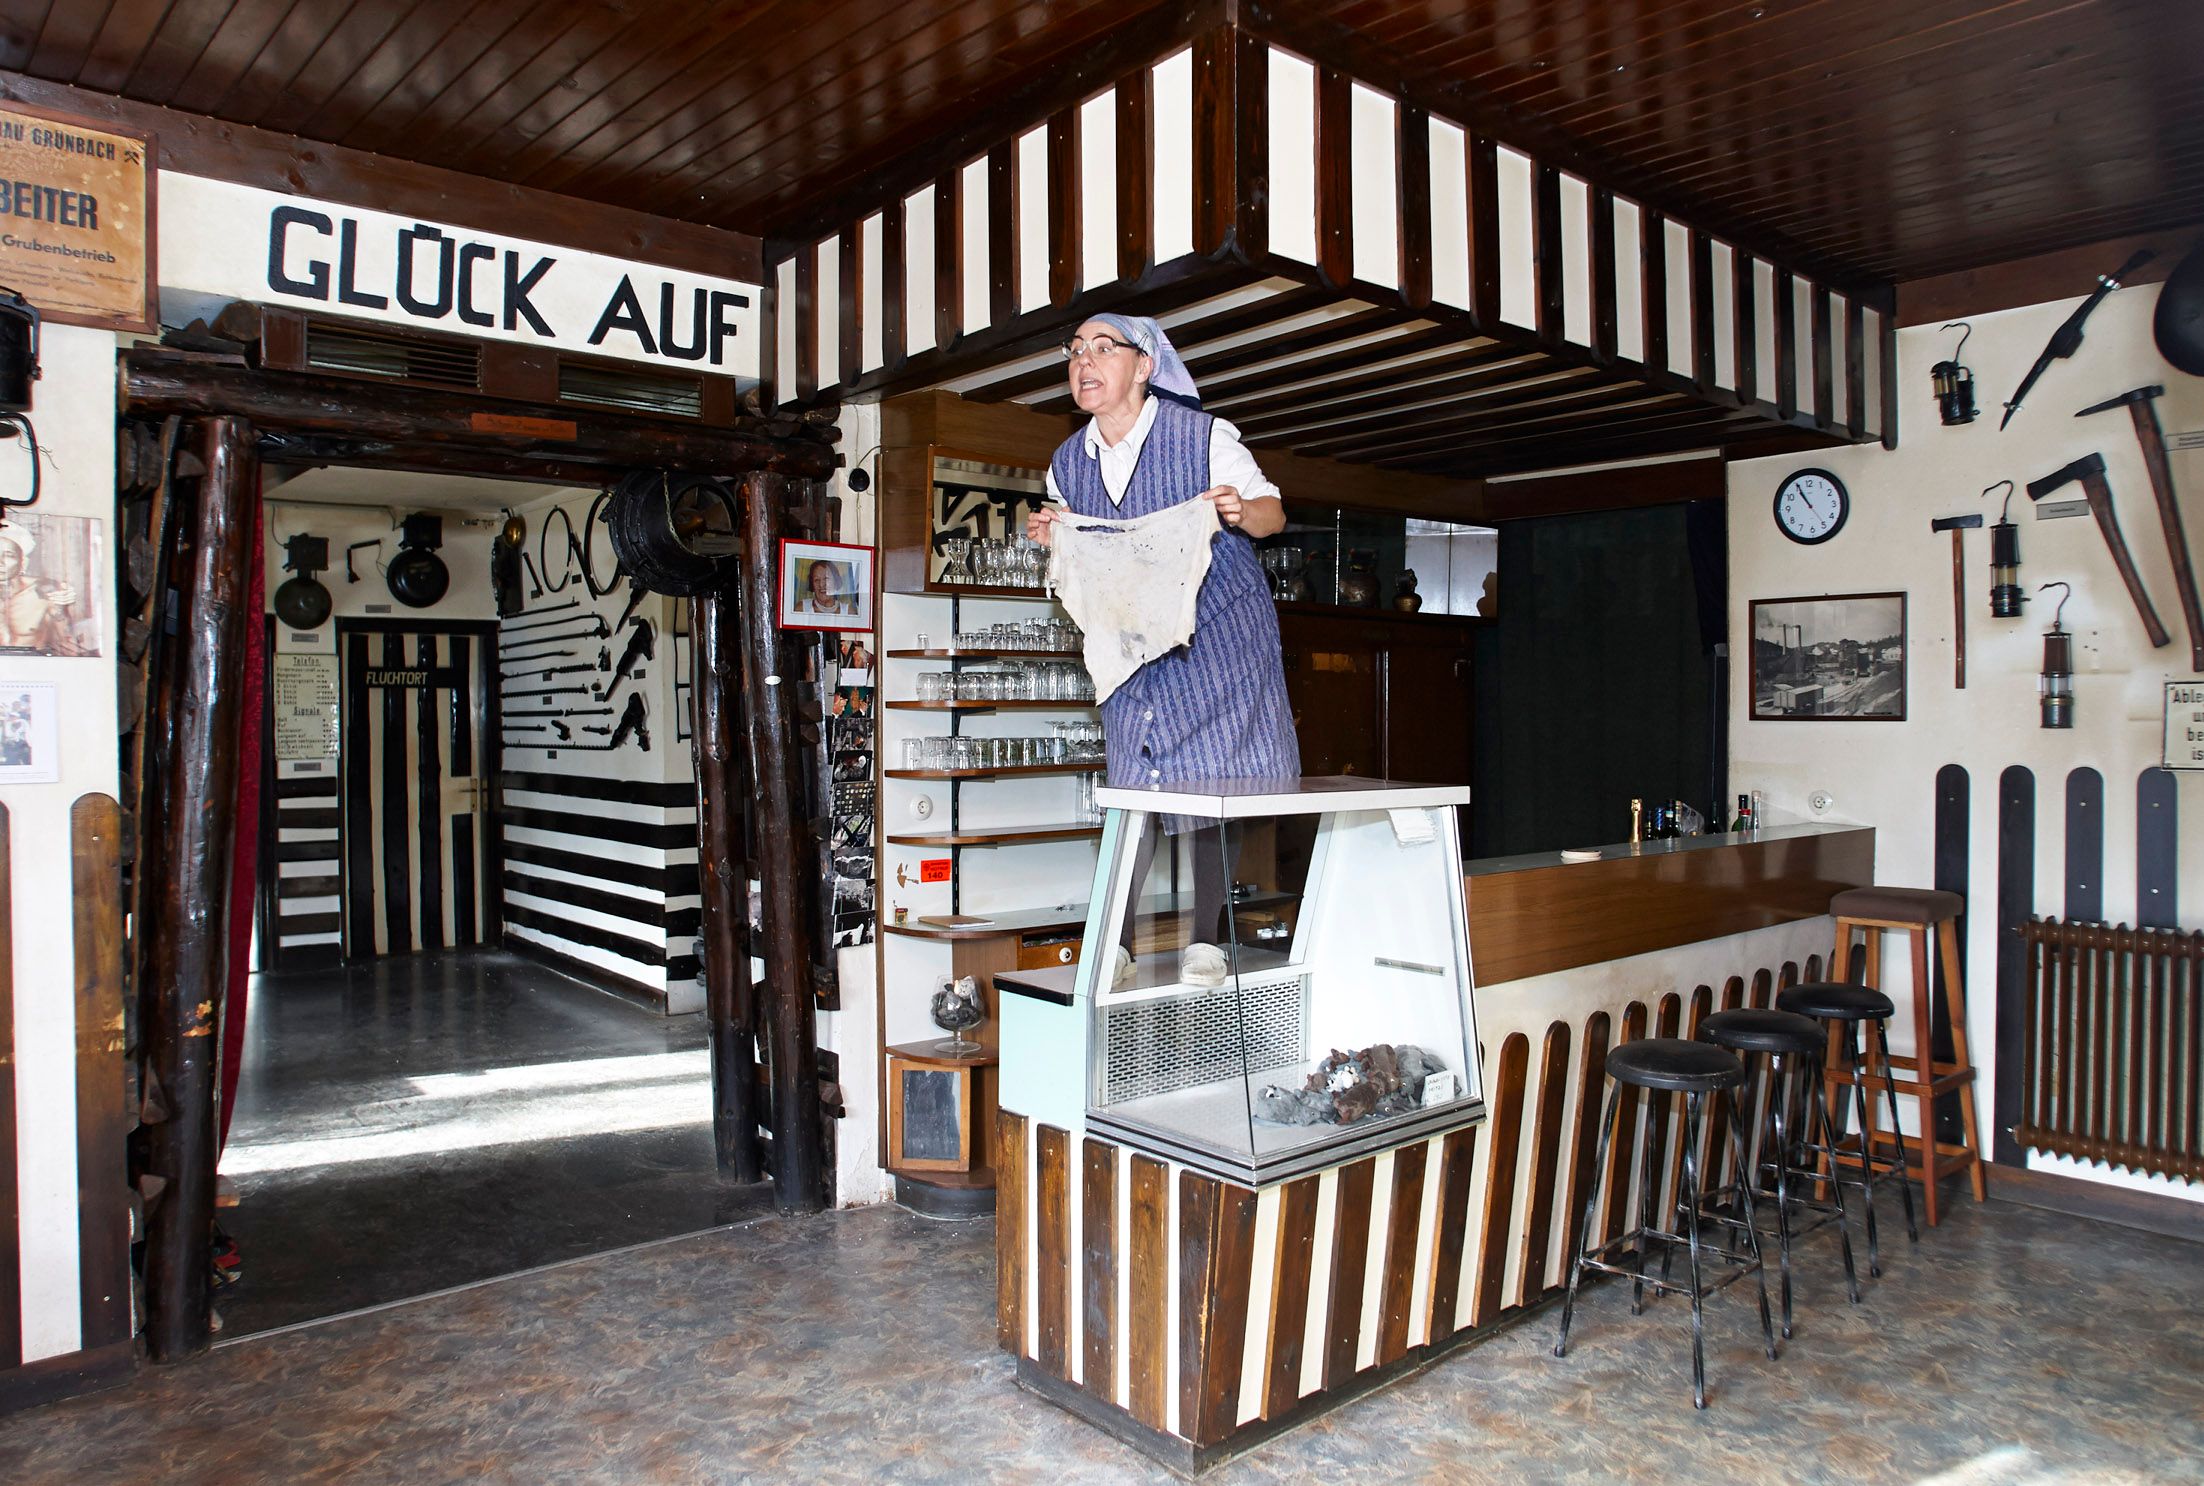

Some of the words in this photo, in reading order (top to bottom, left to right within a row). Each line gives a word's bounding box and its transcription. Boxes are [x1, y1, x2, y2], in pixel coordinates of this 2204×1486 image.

[0, 121, 24, 142] AU
[2, 233, 117, 264] Grubenbetrieb
[267, 205, 557, 338] GLÜCK
[587, 273, 750, 365] AUF
[1805, 479, 1813, 488] 12
[1819, 481, 1823, 489] 1
[1827, 488, 1833, 497] 2
[1786, 493, 1795, 502] 10
[1831, 500, 1837, 508] 3
[1785, 505, 1791, 513] 9
[1789, 516, 1796, 525] 8
[1828, 512, 1835, 520] 4
[1798, 523, 1804, 532] 7
[1820, 520, 1827, 529] 5
[1809, 525, 1816, 534] 6
[366, 671, 428, 685] FLUCHTORT
